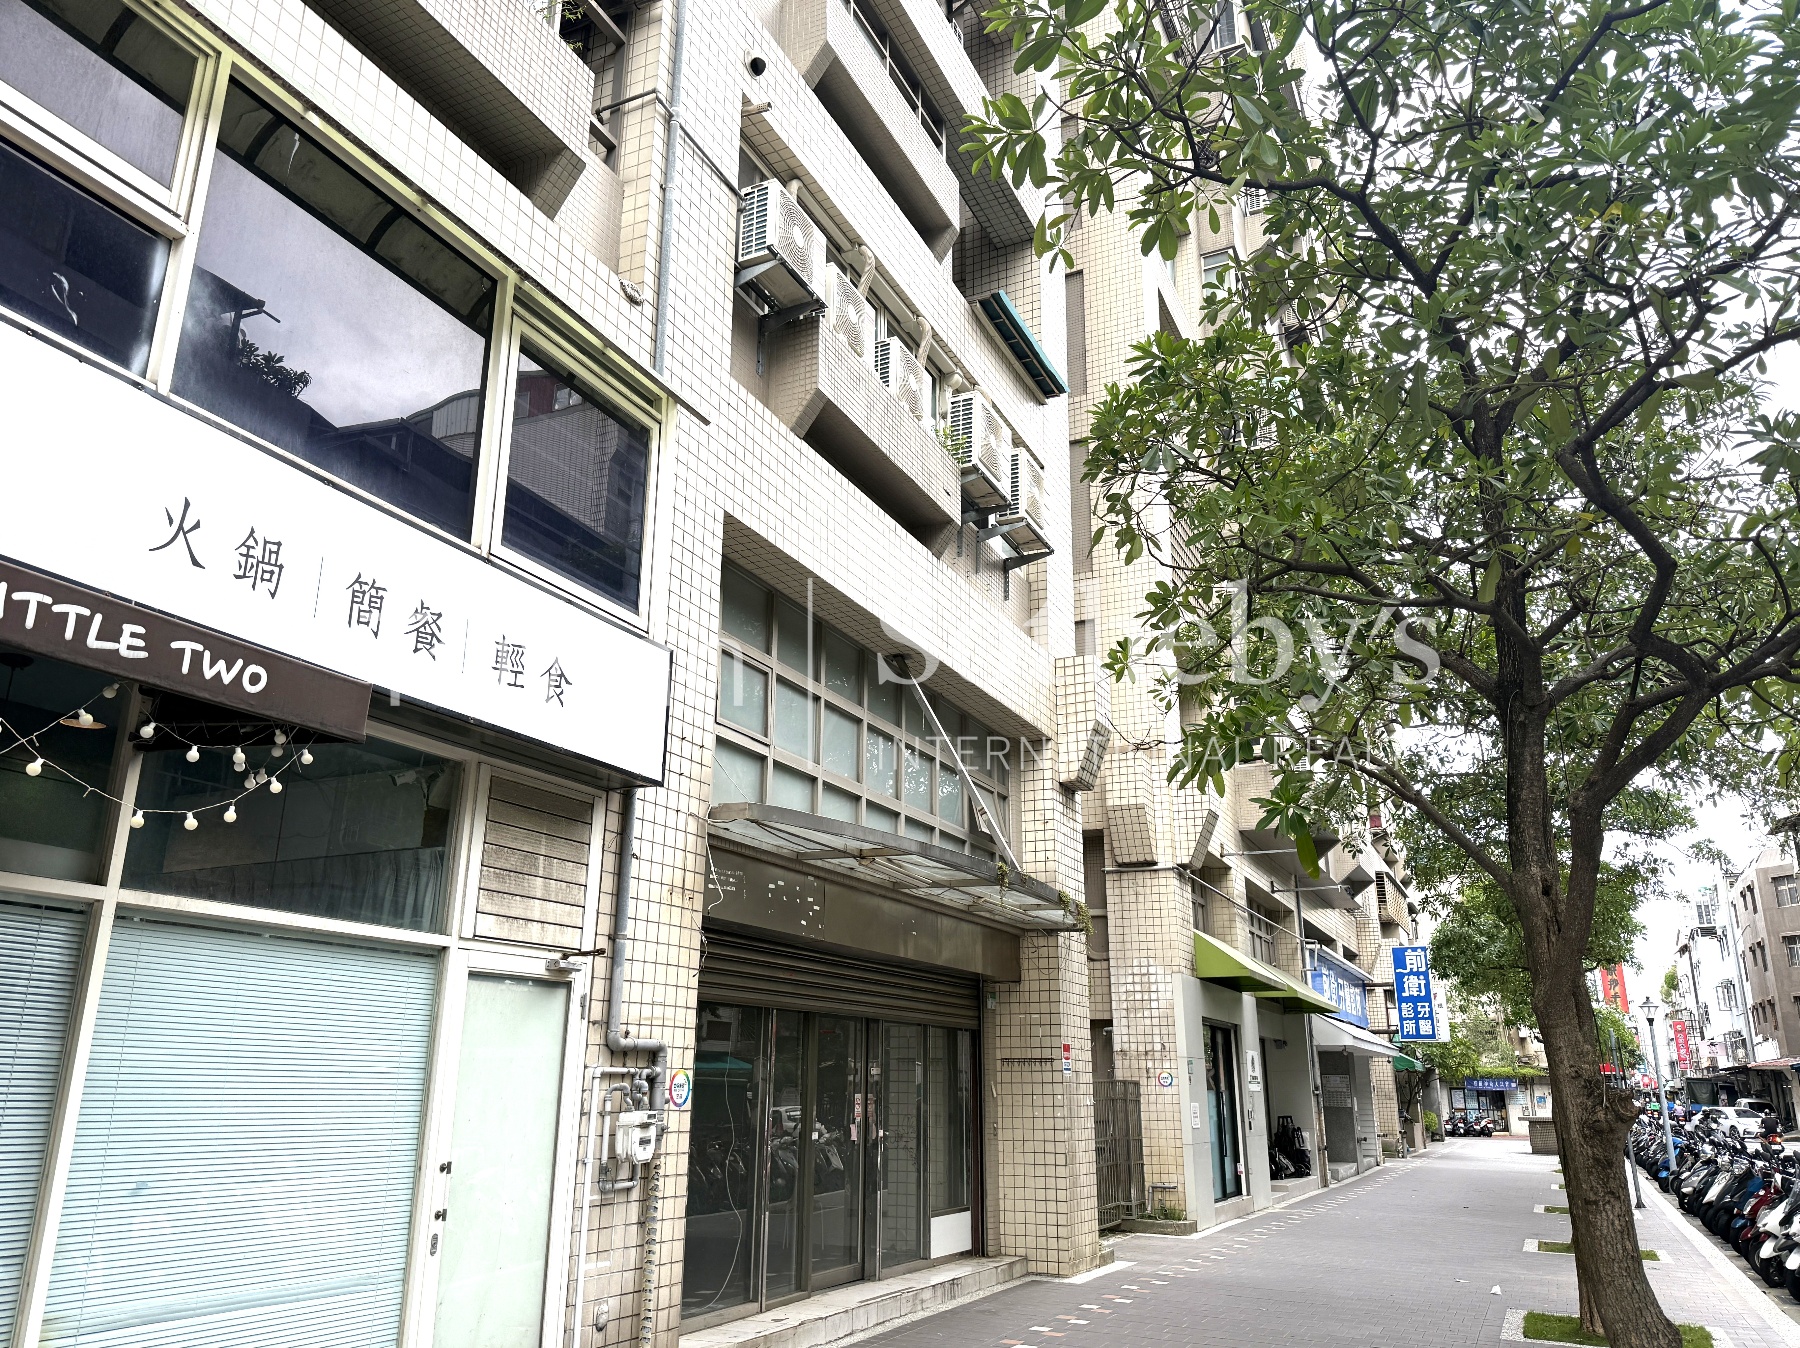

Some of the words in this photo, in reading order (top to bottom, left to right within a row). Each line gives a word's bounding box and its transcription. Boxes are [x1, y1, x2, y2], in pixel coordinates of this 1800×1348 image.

[148, 496, 285, 600] 火鍋
[345, 571, 446, 662] 簡餐
[491, 633, 573, 708] 輕食
[169, 640, 268, 694] TWO
[1395, 948, 1427, 997] 前衛
[1400, 1002, 1417, 1036] 診所
[1416, 1002, 1433, 1035] 牙醫
